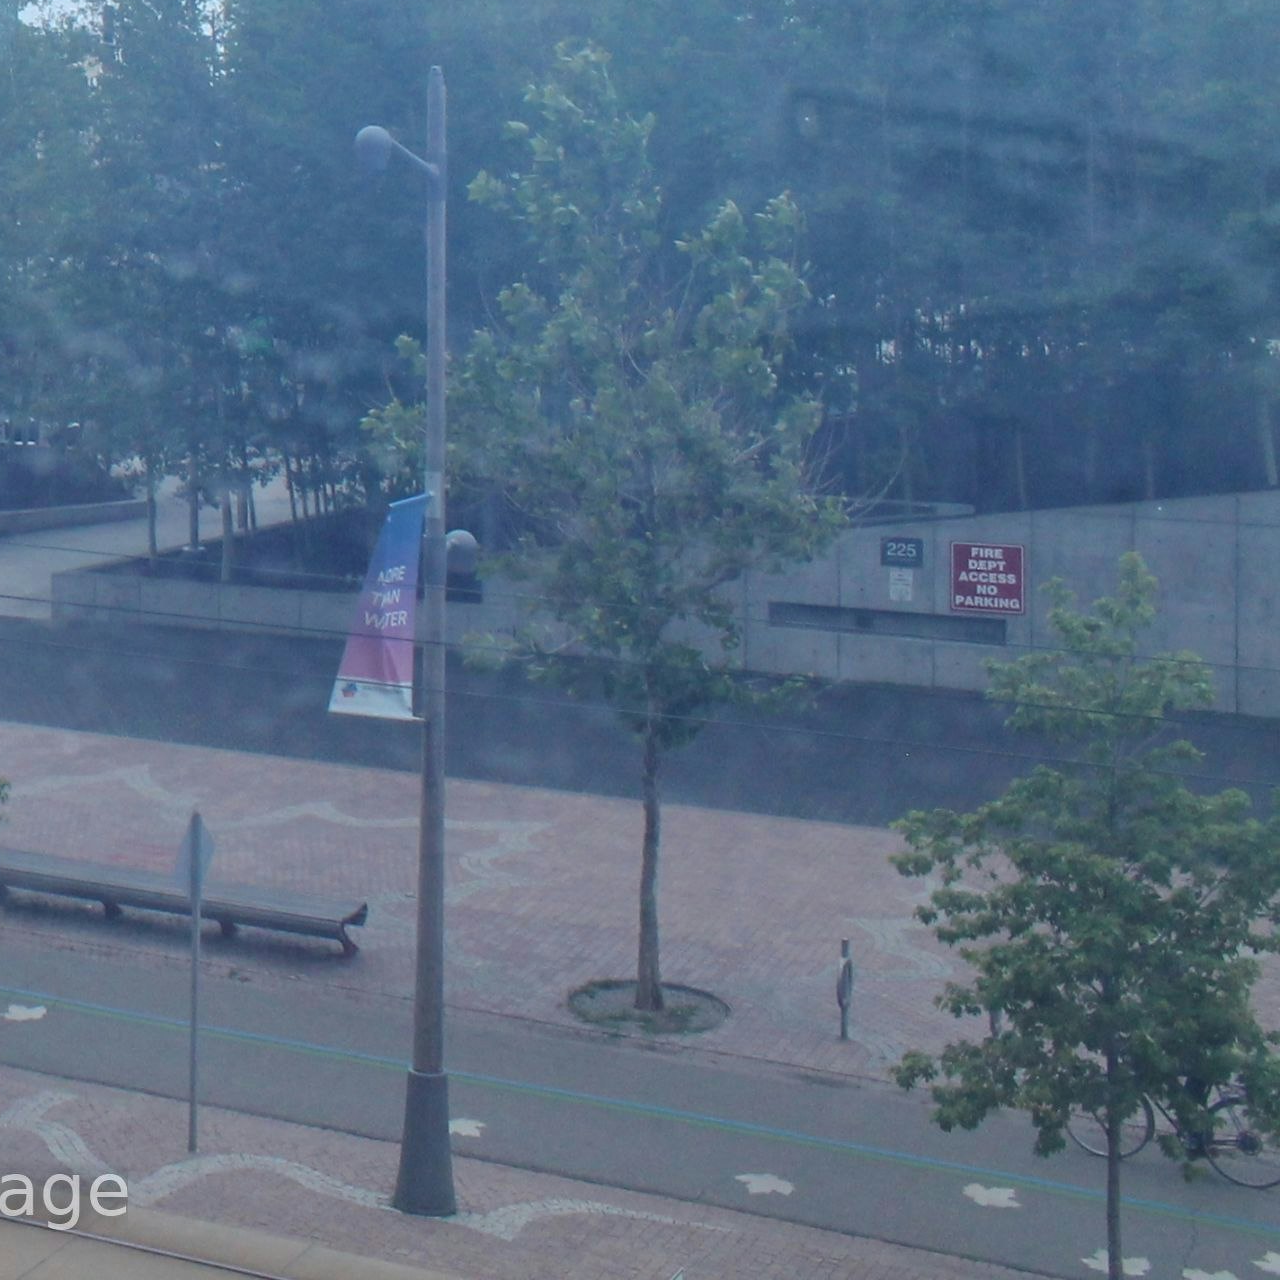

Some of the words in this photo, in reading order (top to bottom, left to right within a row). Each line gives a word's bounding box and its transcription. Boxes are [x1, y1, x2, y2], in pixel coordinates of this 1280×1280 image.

[887, 542, 917, 558] 225
[971, 547, 1003, 560] FIRE
[968, 559, 1006, 571] DEPT
[958, 572, 1017, 584] ACCESS
[976, 585, 998, 596] NO
[955, 595, 1020, 609] PARKING
